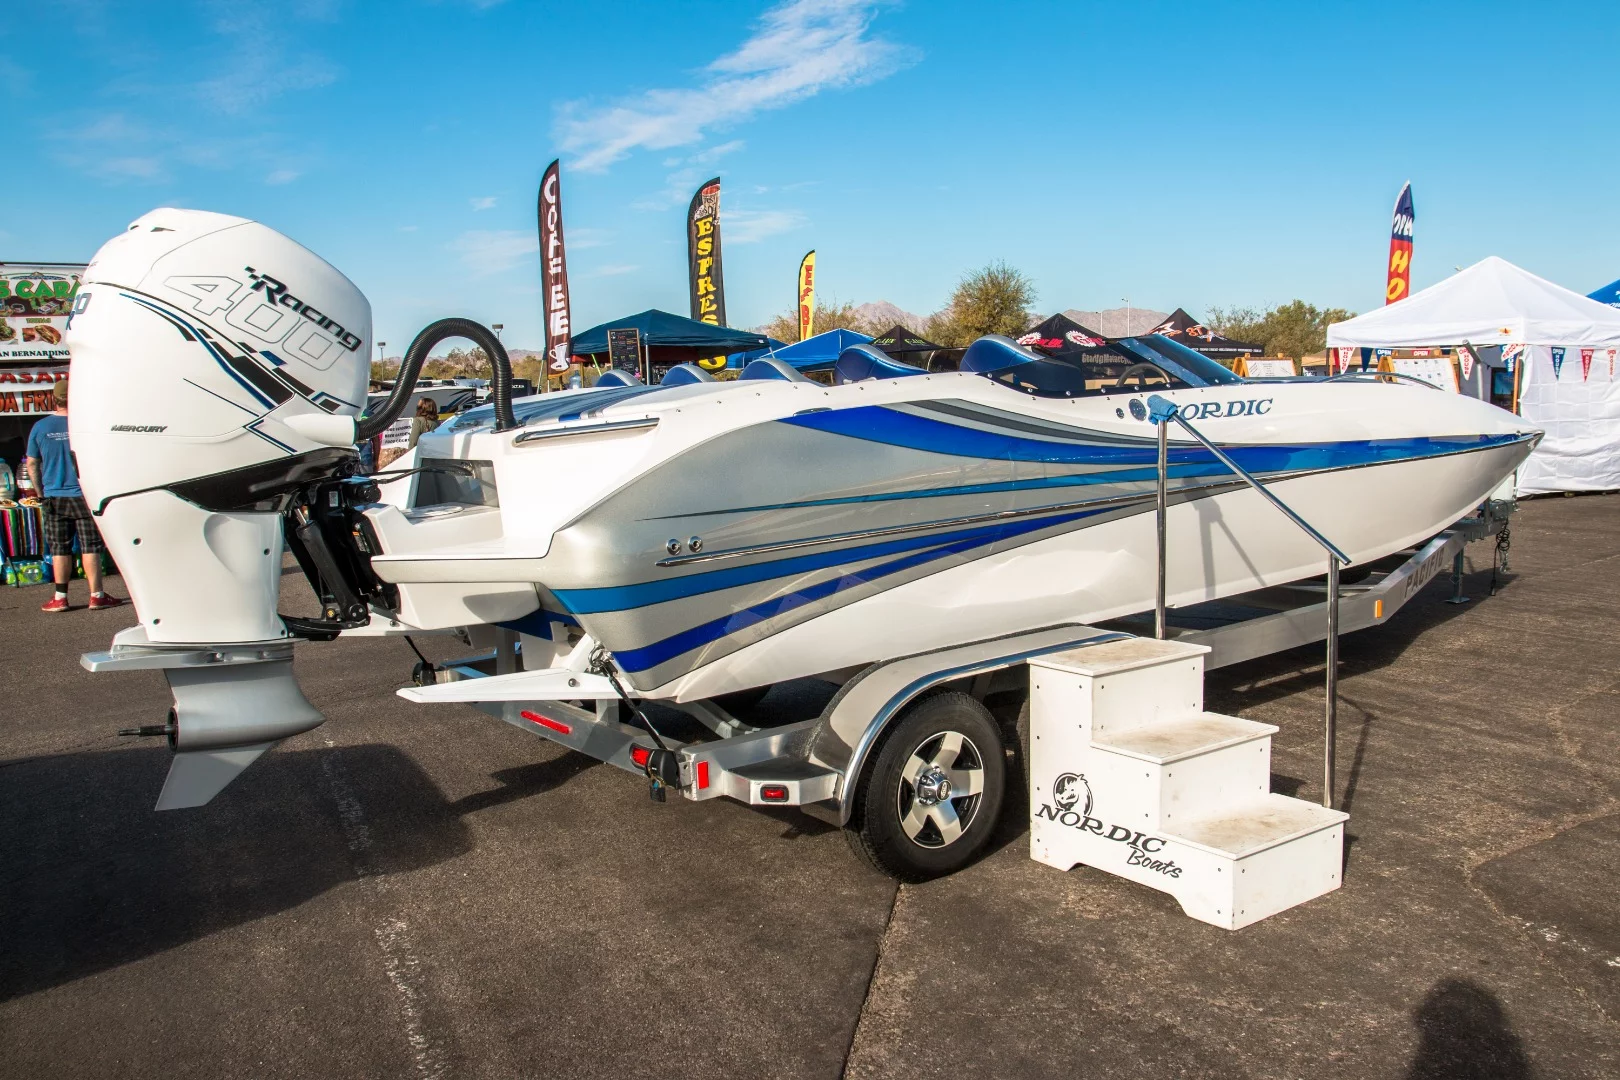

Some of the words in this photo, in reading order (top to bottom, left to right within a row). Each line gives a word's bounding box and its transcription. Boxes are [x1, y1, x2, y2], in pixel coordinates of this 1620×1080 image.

[163, 276, 346, 371] 400
[249, 274, 362, 352] Racing
[22, 389, 57, 412] FRI
[1168, 398, 1273, 422] ORDIC
[111, 424, 168, 432] MERCURY
[1404, 547, 1445, 598] PACIFIC
[1035, 803, 1167, 852] NORDIC
[1126, 846, 1183, 878] Boats
